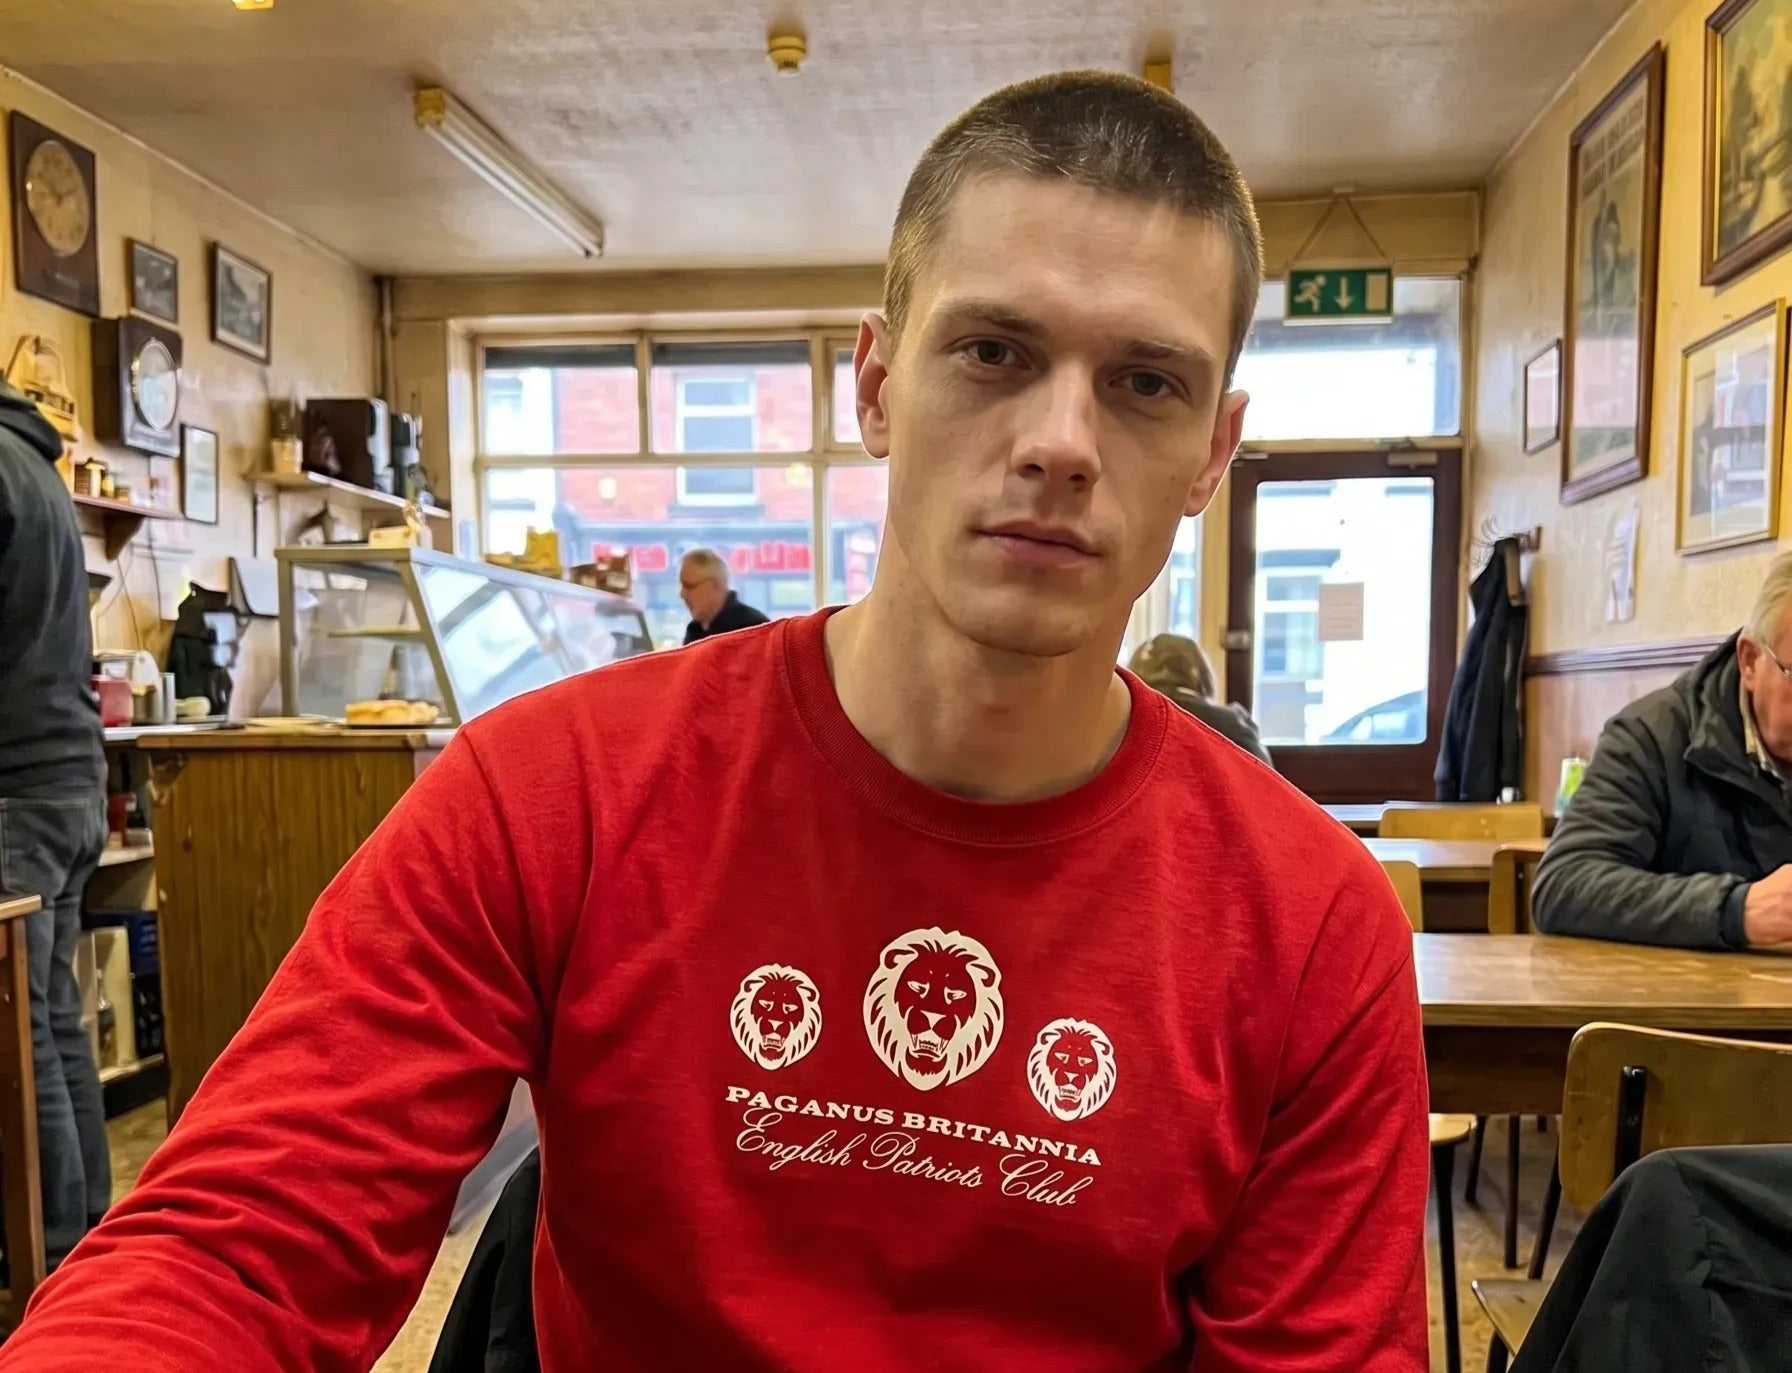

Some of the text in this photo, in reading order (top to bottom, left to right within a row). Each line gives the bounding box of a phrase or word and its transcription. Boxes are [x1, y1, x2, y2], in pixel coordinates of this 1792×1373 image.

[725, 1086, 1102, 1166] PAGANUS BRITANNIA
[736, 1107, 1094, 1206] English Patriots Club
